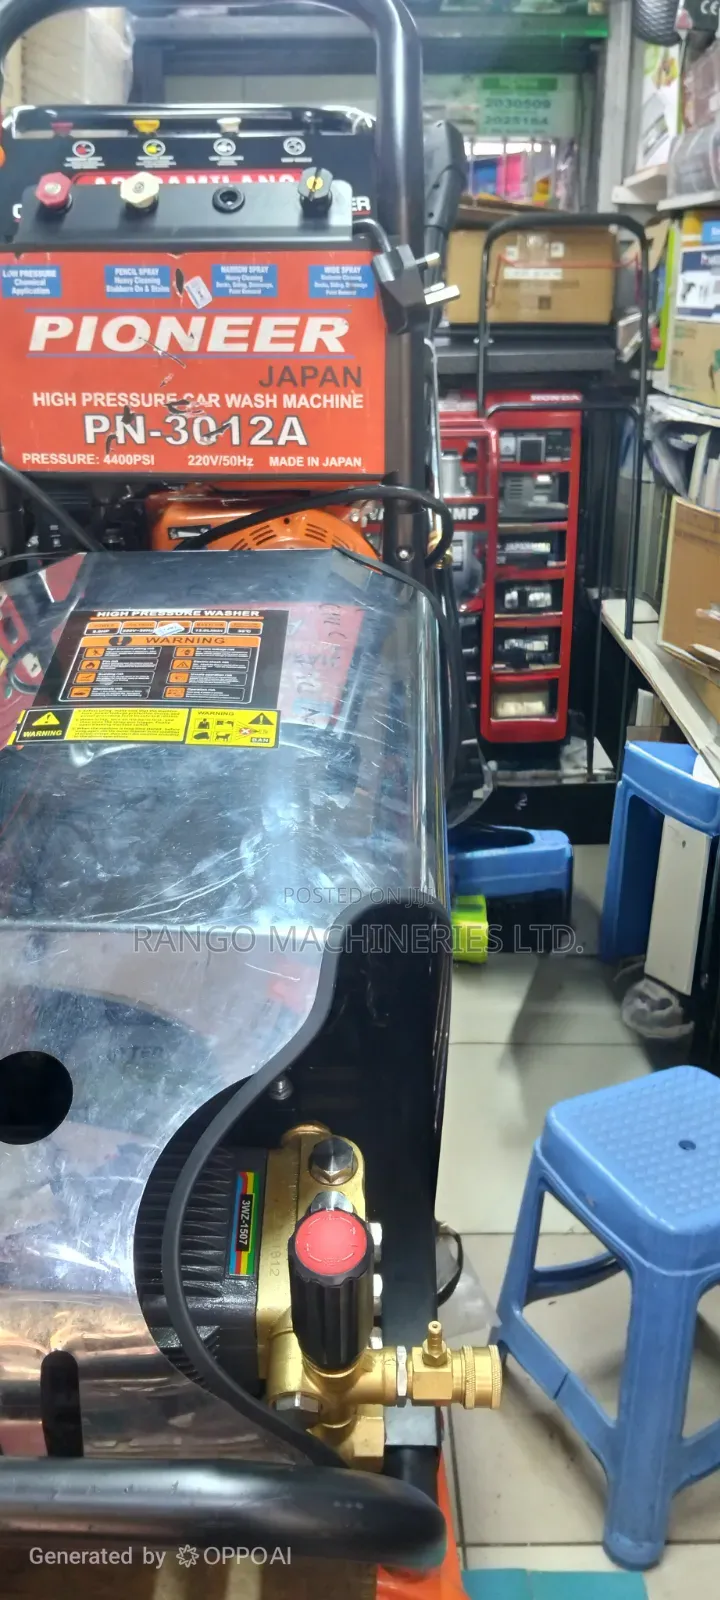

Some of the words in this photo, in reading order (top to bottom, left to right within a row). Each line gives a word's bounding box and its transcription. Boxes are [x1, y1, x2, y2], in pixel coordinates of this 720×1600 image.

[139, 268, 159, 276] SPRAY
[249, 265, 269, 273] SPRAY
[341, 266, 361, 274] SPRAY
[28, 315, 350, 353] PIONEER
[259, 365, 363, 389] JAPAN
[32, 391, 77, 408] HIGH
[81, 392, 178, 408] PRESSURE
[185, 393, 221, 409] CAR
[224, 393, 278, 409] WASH
[282, 393, 364, 410] MACHINE
[83, 411, 309, 447] PN-3012A
[22, 453, 99, 466] PRESSURE:
[102, 454, 155, 467] 4400PSI
[187, 455, 254, 468] 220V/50Hz
[268, 456, 304, 468] MADE
[306, 456, 319, 468] IN
[321, 456, 363, 468] JAPAN
[96, 610, 129, 618] HIGH
[131, 610, 202, 618] PRESSURE
[203, 610, 260, 618] WASHER
[145, 636, 226, 645] WARNING
[23, 730, 62, 738] WARNING
[238, 1199, 251, 1246] 3WZ-1507
